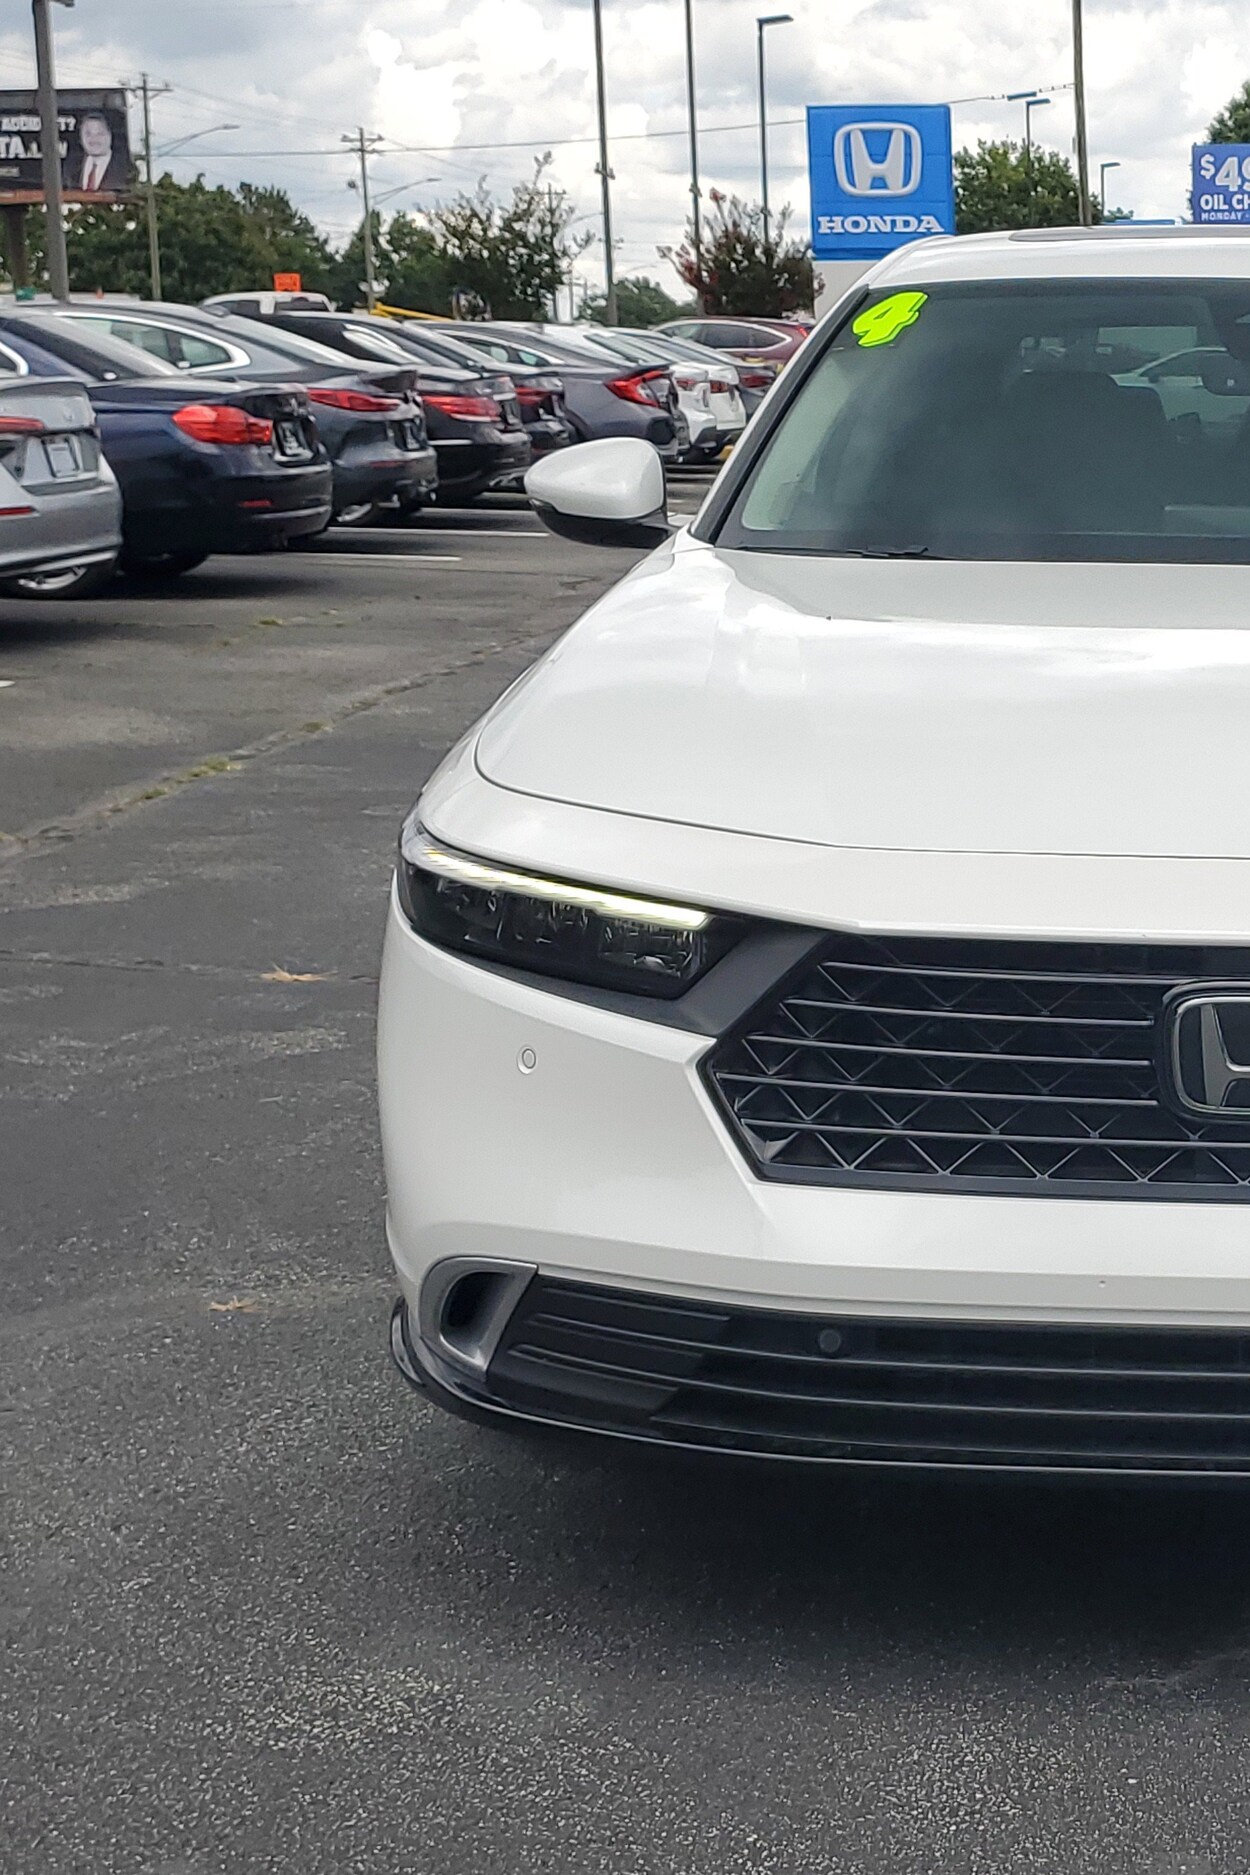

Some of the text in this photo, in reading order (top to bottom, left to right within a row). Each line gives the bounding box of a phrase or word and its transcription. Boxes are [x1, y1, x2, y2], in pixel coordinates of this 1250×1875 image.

[1200, 194, 1229, 211] OIL
[817, 215, 945, 234] HONDA
[1200, 211, 1243, 222] MONDAY
[852, 291, 929, 348] 4
